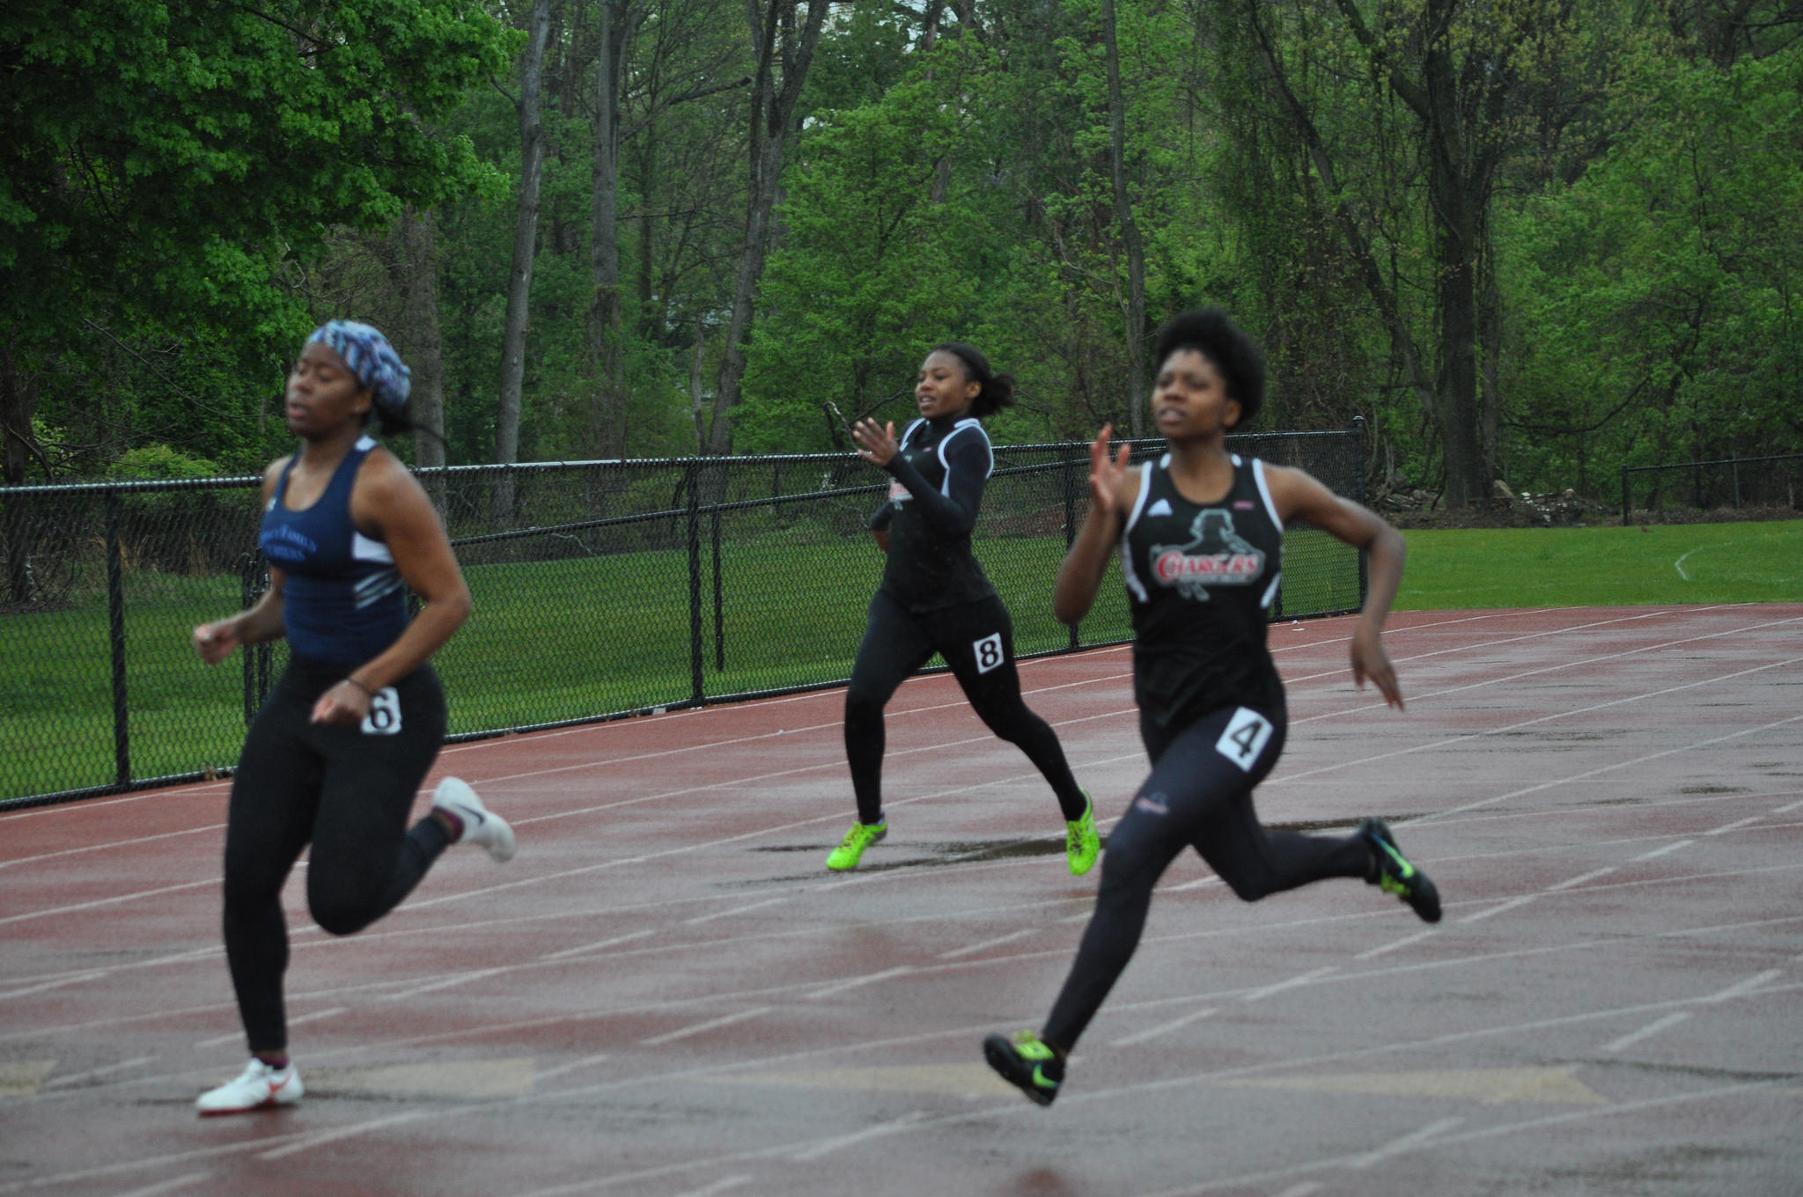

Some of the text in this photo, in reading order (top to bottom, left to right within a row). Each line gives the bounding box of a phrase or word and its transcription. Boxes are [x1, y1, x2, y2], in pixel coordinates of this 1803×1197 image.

[980, 640, 999, 668] 8
[370, 692, 392, 730] 6
[1231, 719, 1263, 758] 4
